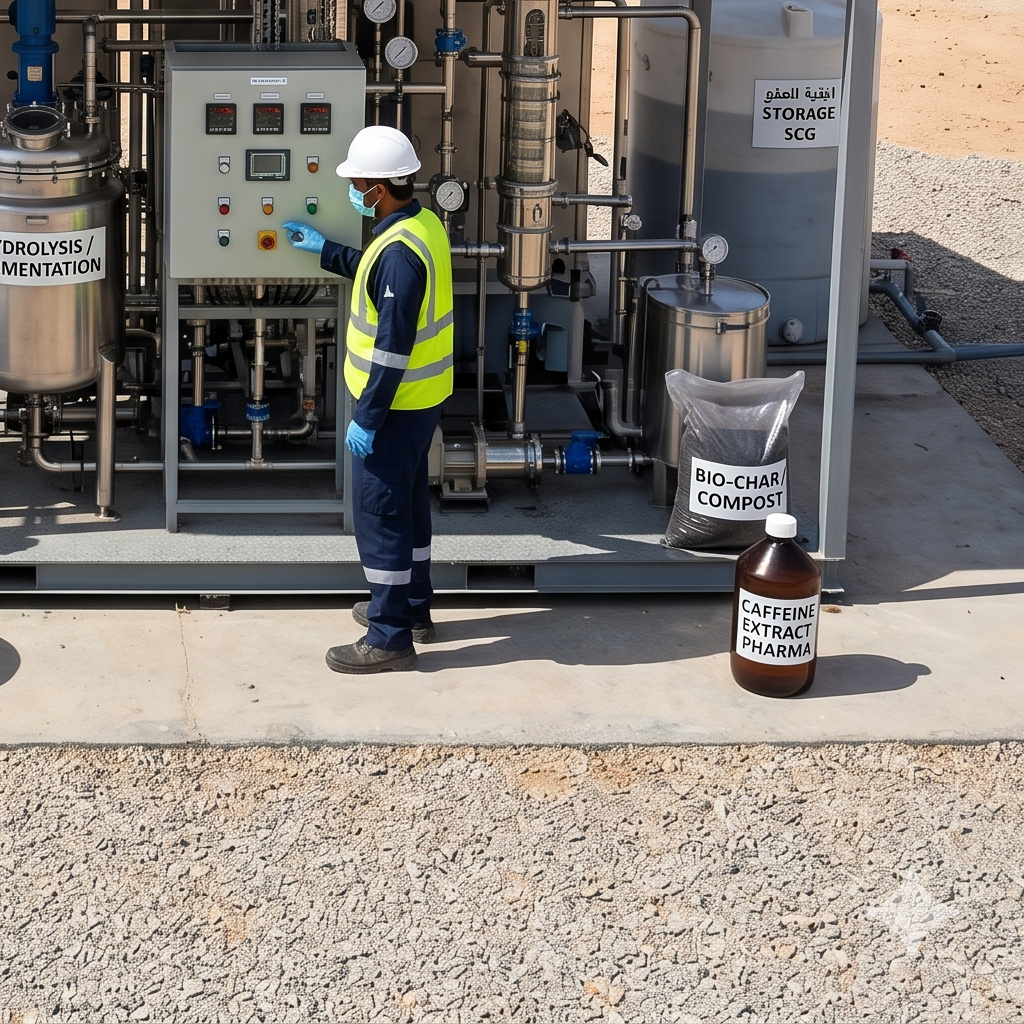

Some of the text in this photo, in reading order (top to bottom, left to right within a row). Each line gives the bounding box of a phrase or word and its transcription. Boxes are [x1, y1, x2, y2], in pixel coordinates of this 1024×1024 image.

[762, 106, 836, 121] STORAGE
[784, 127, 816, 141] SCG
[85, 235, 95, 256] /
[697, 491, 783, 510] COMPOST
[742, 599, 815, 621] CAFFEINE
[742, 617, 813, 640] EXTRACT
[742, 635, 812, 658] PHARMA
